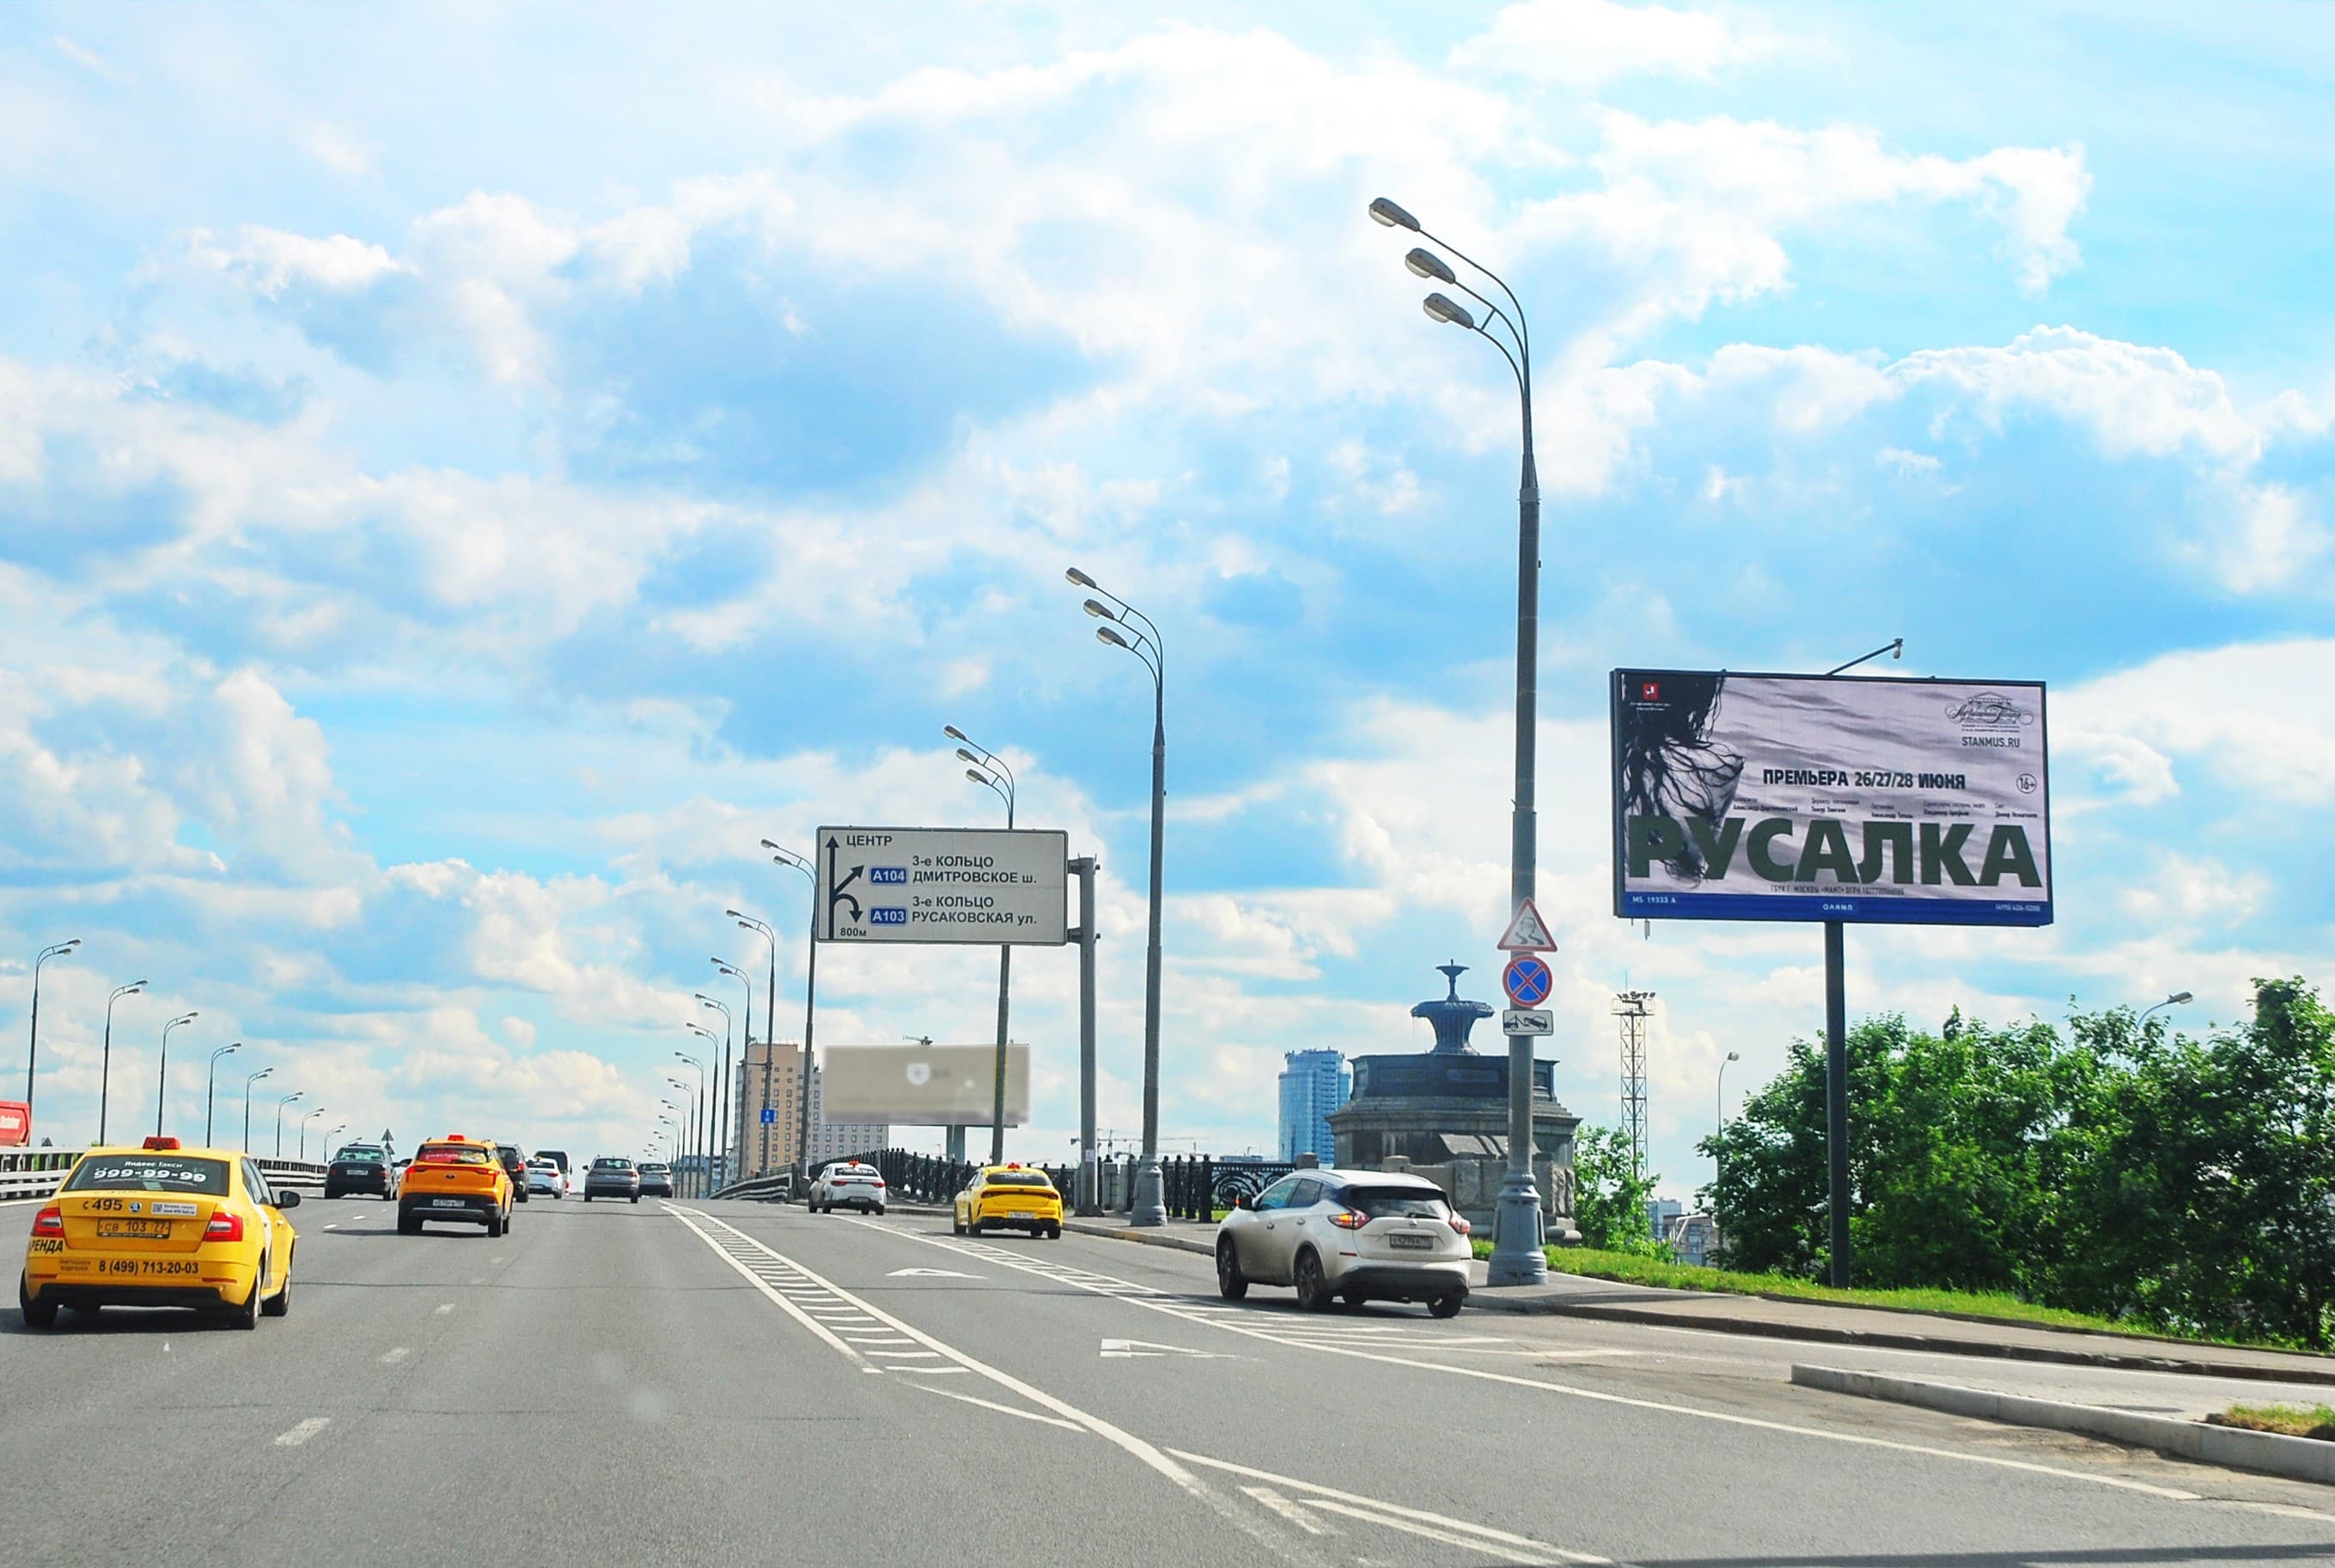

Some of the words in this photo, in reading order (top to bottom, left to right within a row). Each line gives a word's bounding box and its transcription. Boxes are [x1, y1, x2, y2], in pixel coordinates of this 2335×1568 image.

[1961, 736, 2020, 747] STANMUS.RU
[1763, 769, 1849, 787] ПРЕМЬЕРА
[1854, 772, 1914, 789] 26/27/28
[1918, 772, 1966, 790] ИЮНЯ
[2018, 777, 2035, 790] 16+
[846, 835, 893, 847] ЦЕНТР
[1628, 815, 2042, 888] РУСАЛКА
[912, 856, 932, 867] 3-е
[936, 856, 994, 869] КОЛЬЦО
[912, 871, 1018, 884] ДМИТРОВСКОЕ
[1022, 874, 1037, 884] ш.
[912, 896, 932, 906] 3-е
[936, 896, 994, 910] КОЛЬЦО
[912, 911, 1013, 924] РУСАКОВСКАЯ
[1017, 914, 1037, 927] ул.
[840, 928, 867, 937] 800м
[94, 1168, 206, 1182] 999-99-99
[125, 1222, 146, 1232] 103
[99, 1260, 106, 1272] 8
[109, 1260, 138, 1275] (499)
[143, 1262, 199, 1273] 713-20-03
